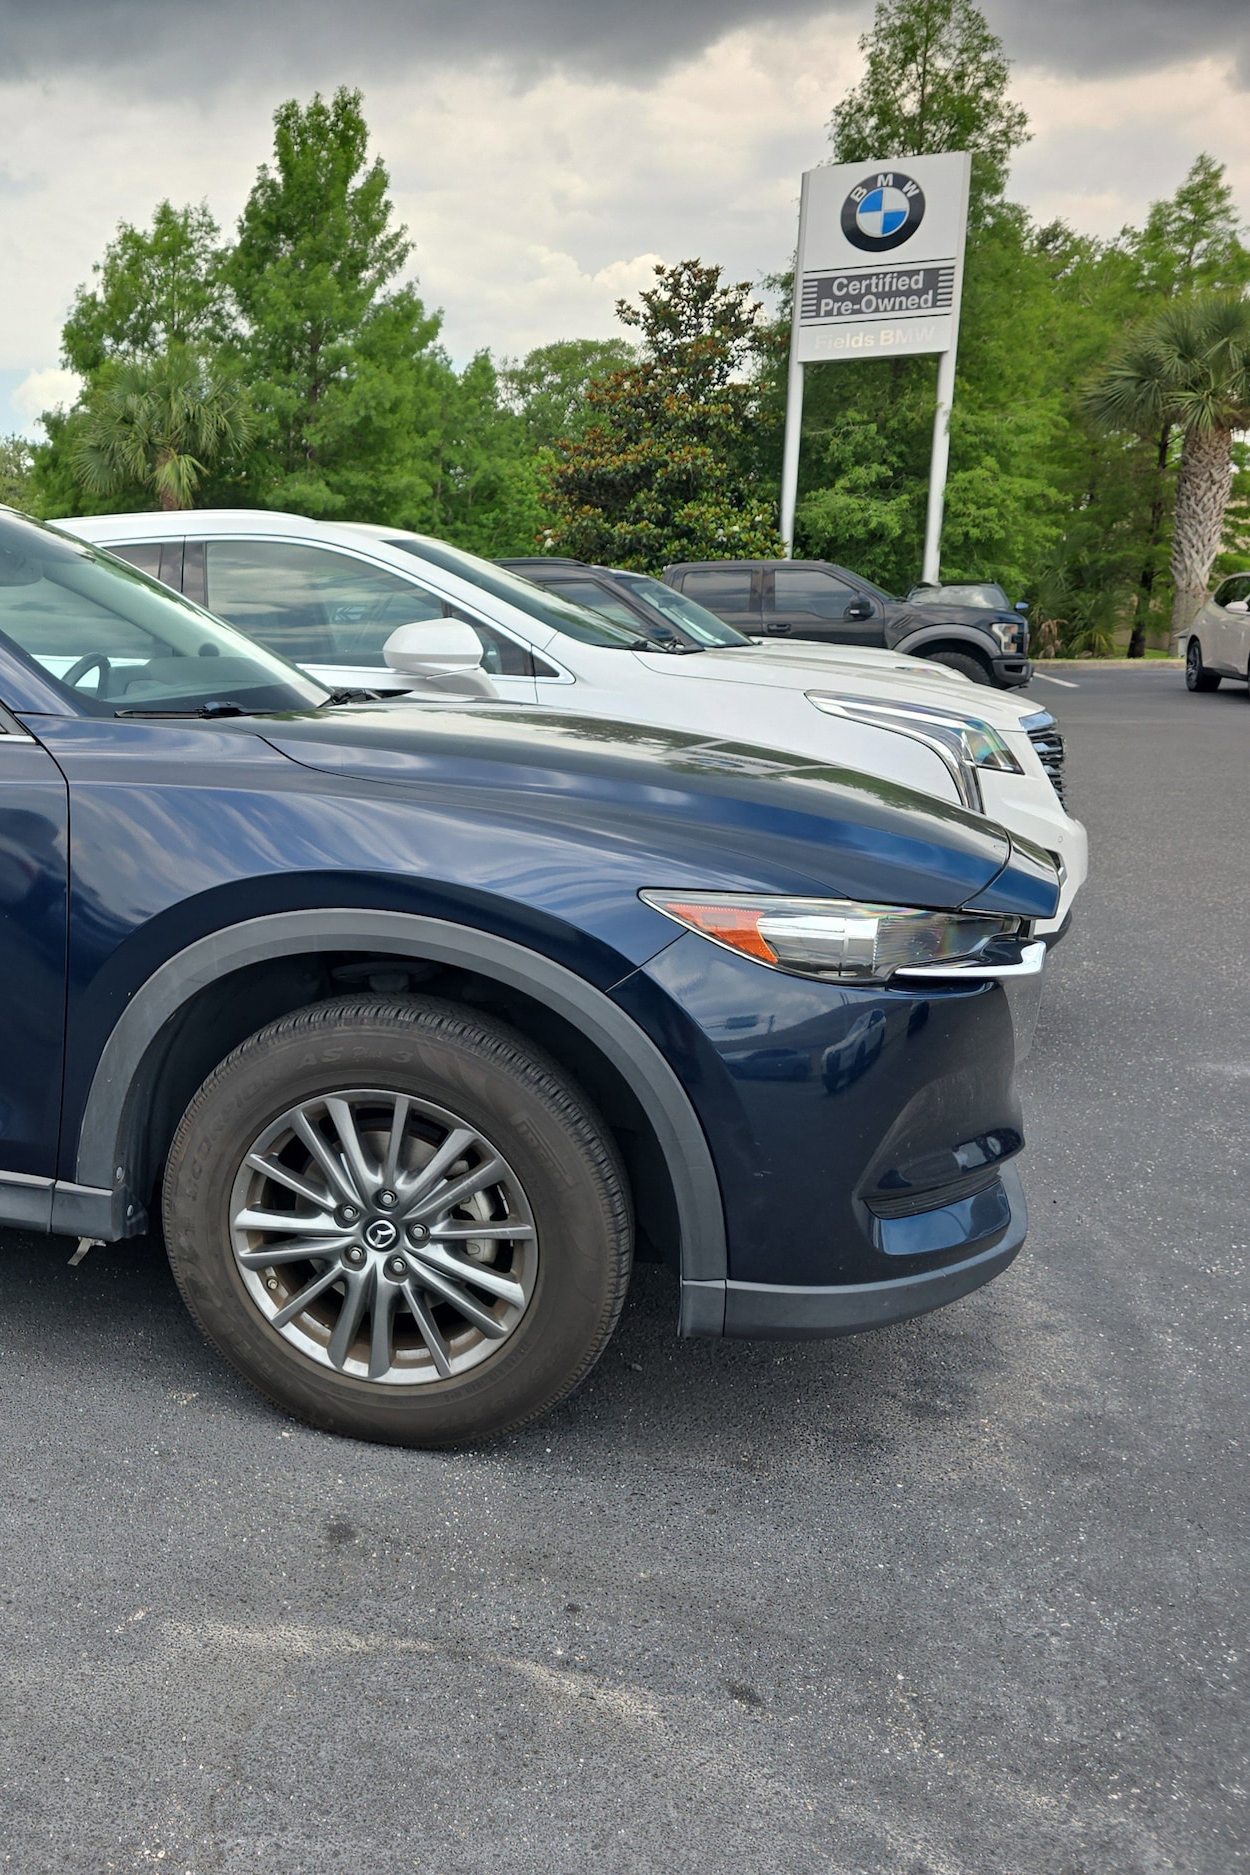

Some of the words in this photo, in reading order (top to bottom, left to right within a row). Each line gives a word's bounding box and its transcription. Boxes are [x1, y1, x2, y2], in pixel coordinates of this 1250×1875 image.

[850, 173, 920, 203] BMW
[832, 271, 924, 296] Certified
[820, 290, 934, 316] Pre-Owned
[814, 332, 875, 350] Fields
[880, 327, 935, 346] BMW
